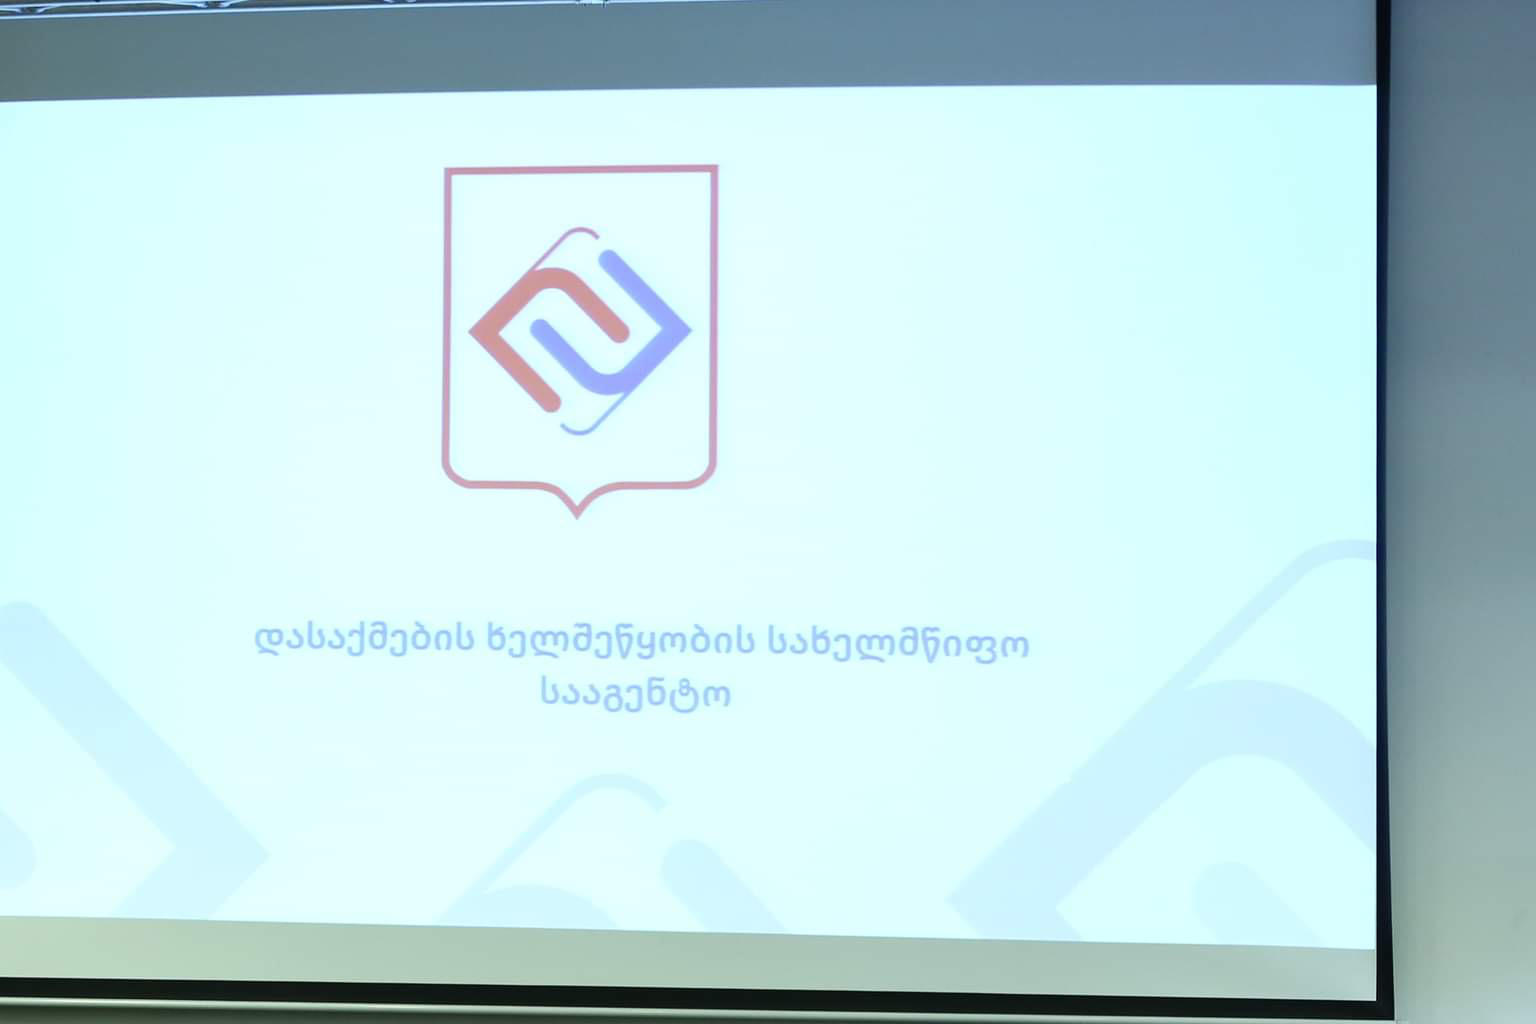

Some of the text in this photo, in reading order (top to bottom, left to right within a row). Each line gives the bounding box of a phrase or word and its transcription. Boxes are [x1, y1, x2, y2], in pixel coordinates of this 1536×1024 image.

[254, 620, 1030, 664] დასაქმების ხელშეწყობის სახელმწიფო
[540, 675, 732, 714] სააგენტო
